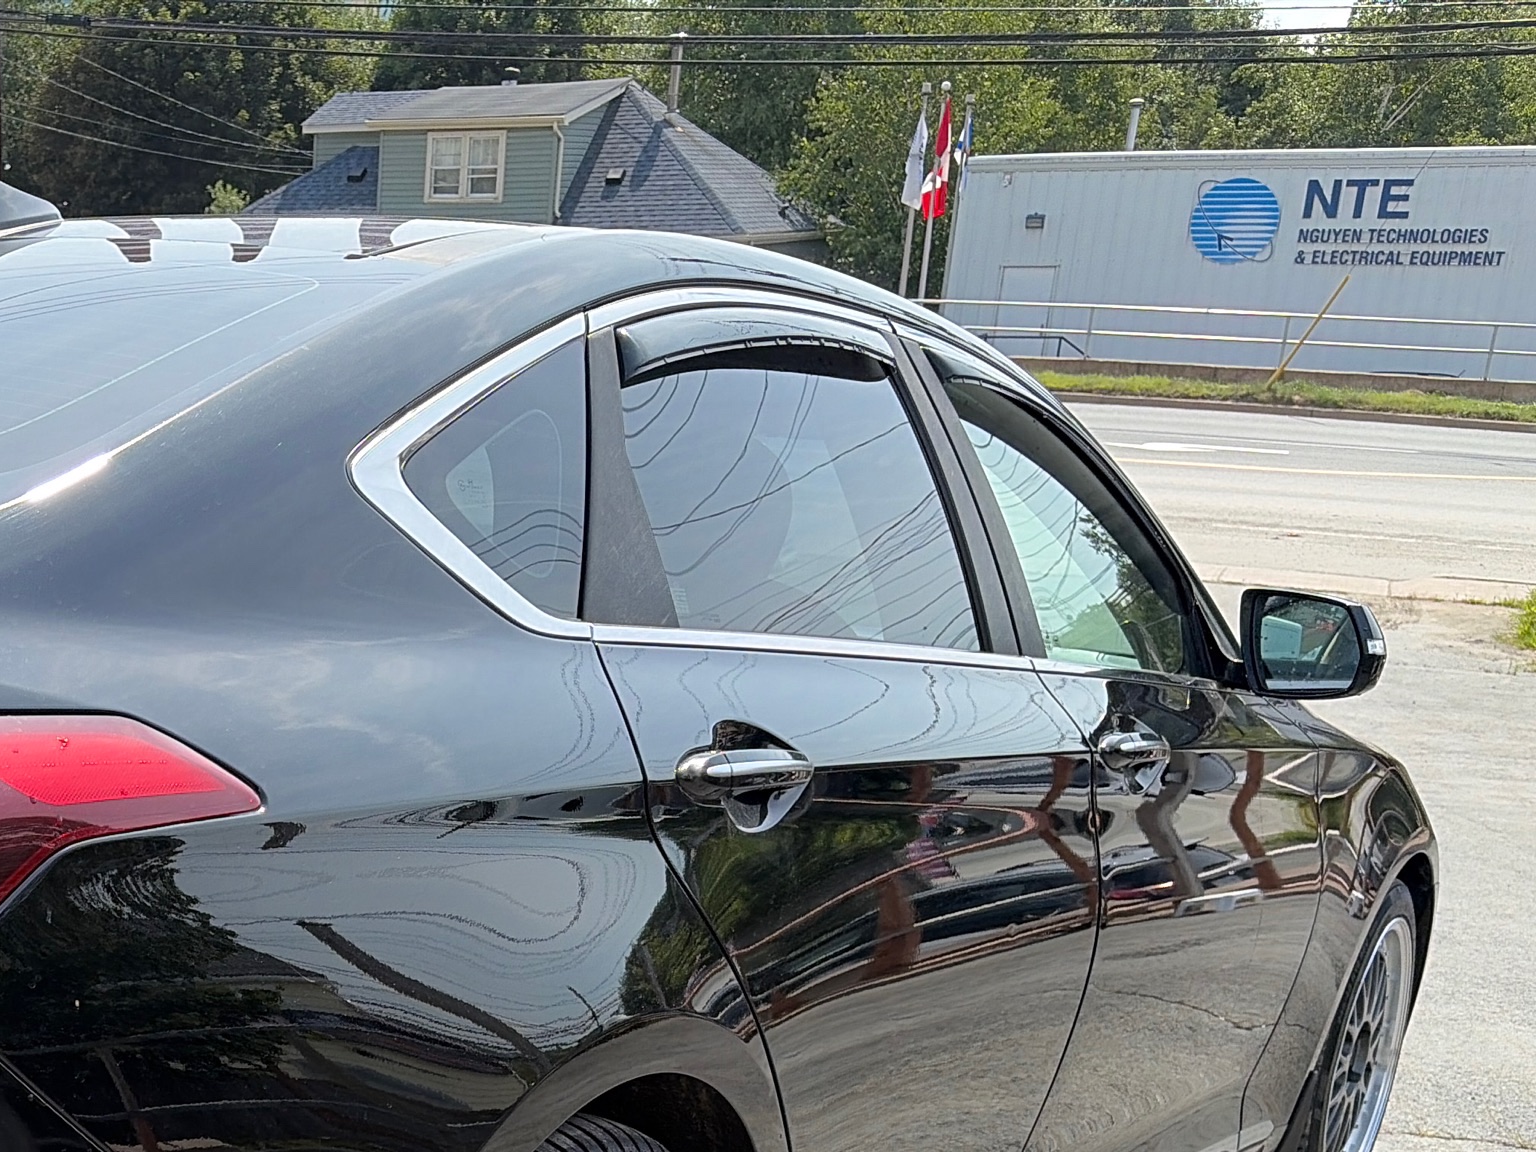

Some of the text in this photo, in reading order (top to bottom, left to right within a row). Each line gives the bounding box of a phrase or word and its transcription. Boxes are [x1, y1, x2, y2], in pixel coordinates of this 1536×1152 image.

[1302, 179, 1414, 220] NTE
[1297, 228, 1490, 245] NGUYEN TECHNOLOGIES
[1294, 250, 1506, 267] & ELECTRICAL EQUIPMENT
